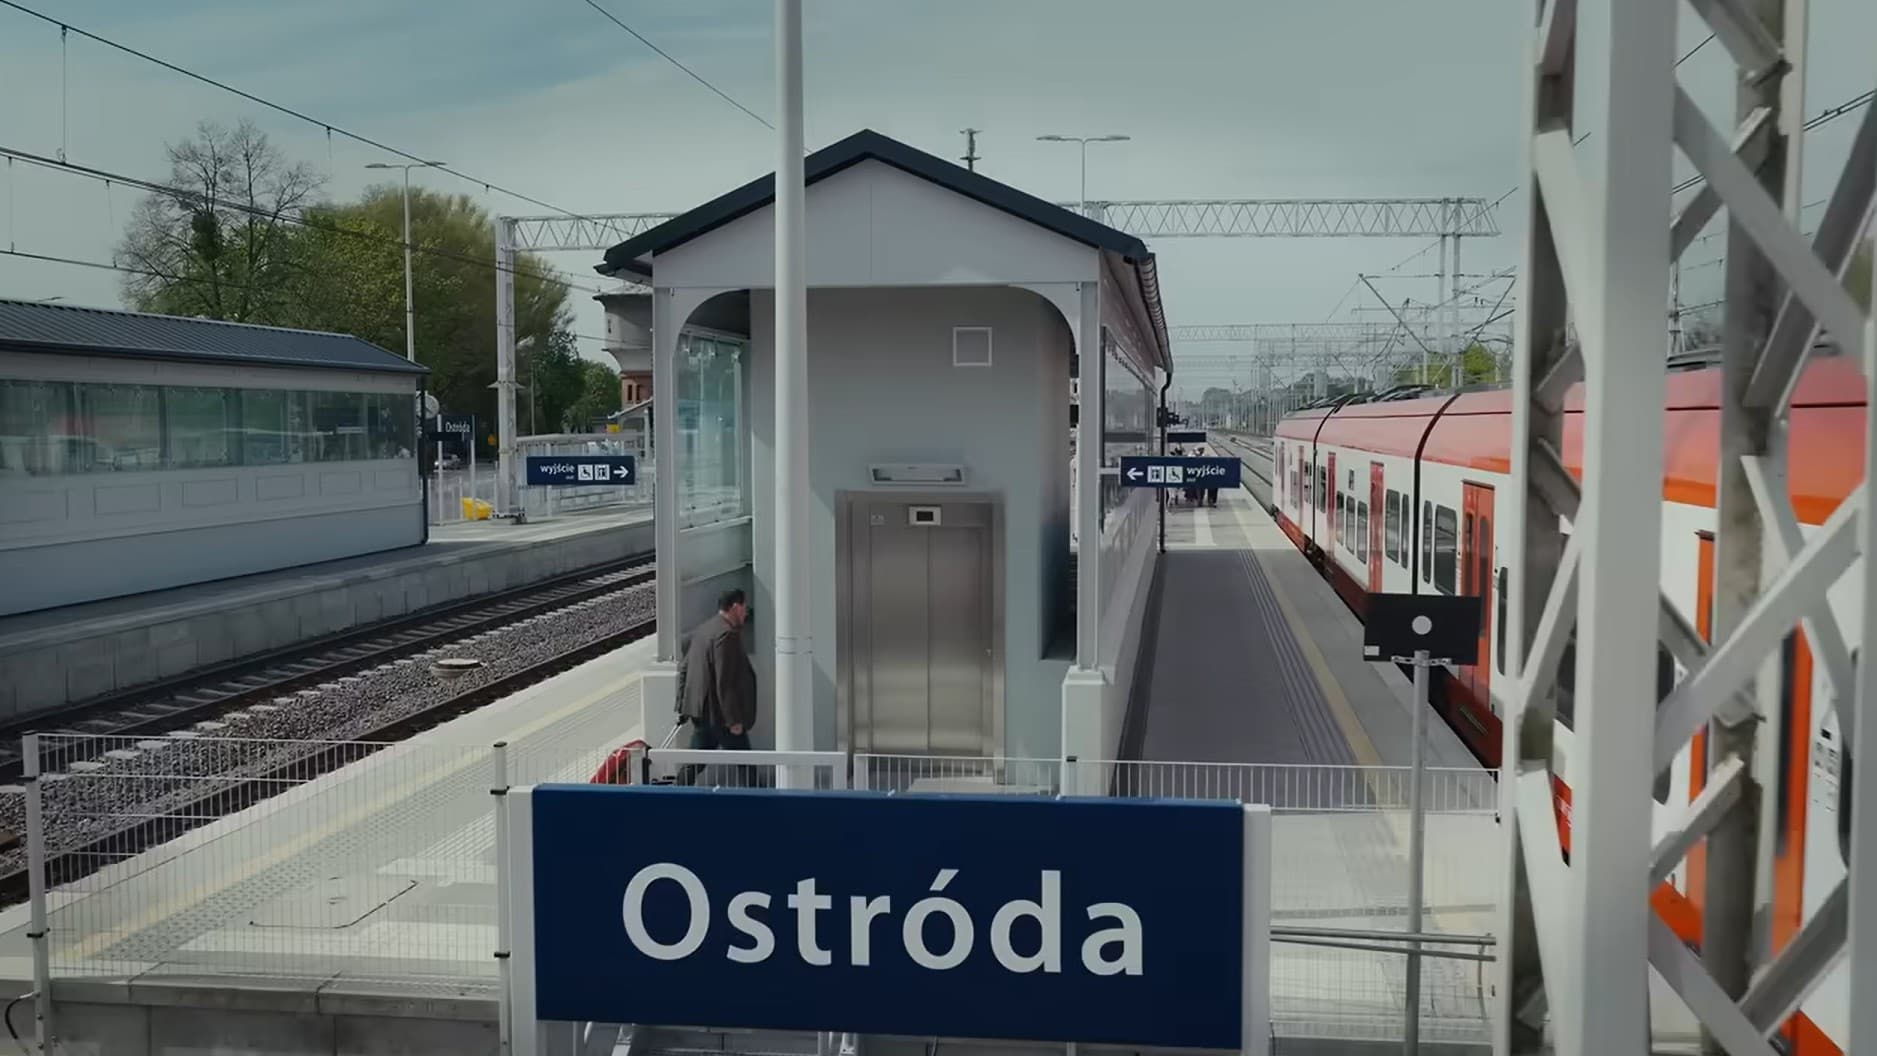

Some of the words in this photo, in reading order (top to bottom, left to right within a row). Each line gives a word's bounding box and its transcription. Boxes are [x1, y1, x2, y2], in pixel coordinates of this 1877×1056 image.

[540, 463, 575, 475] wyjście
[1186, 464, 1226, 477] wyjście
[622, 863, 1143, 976] Ostróda
